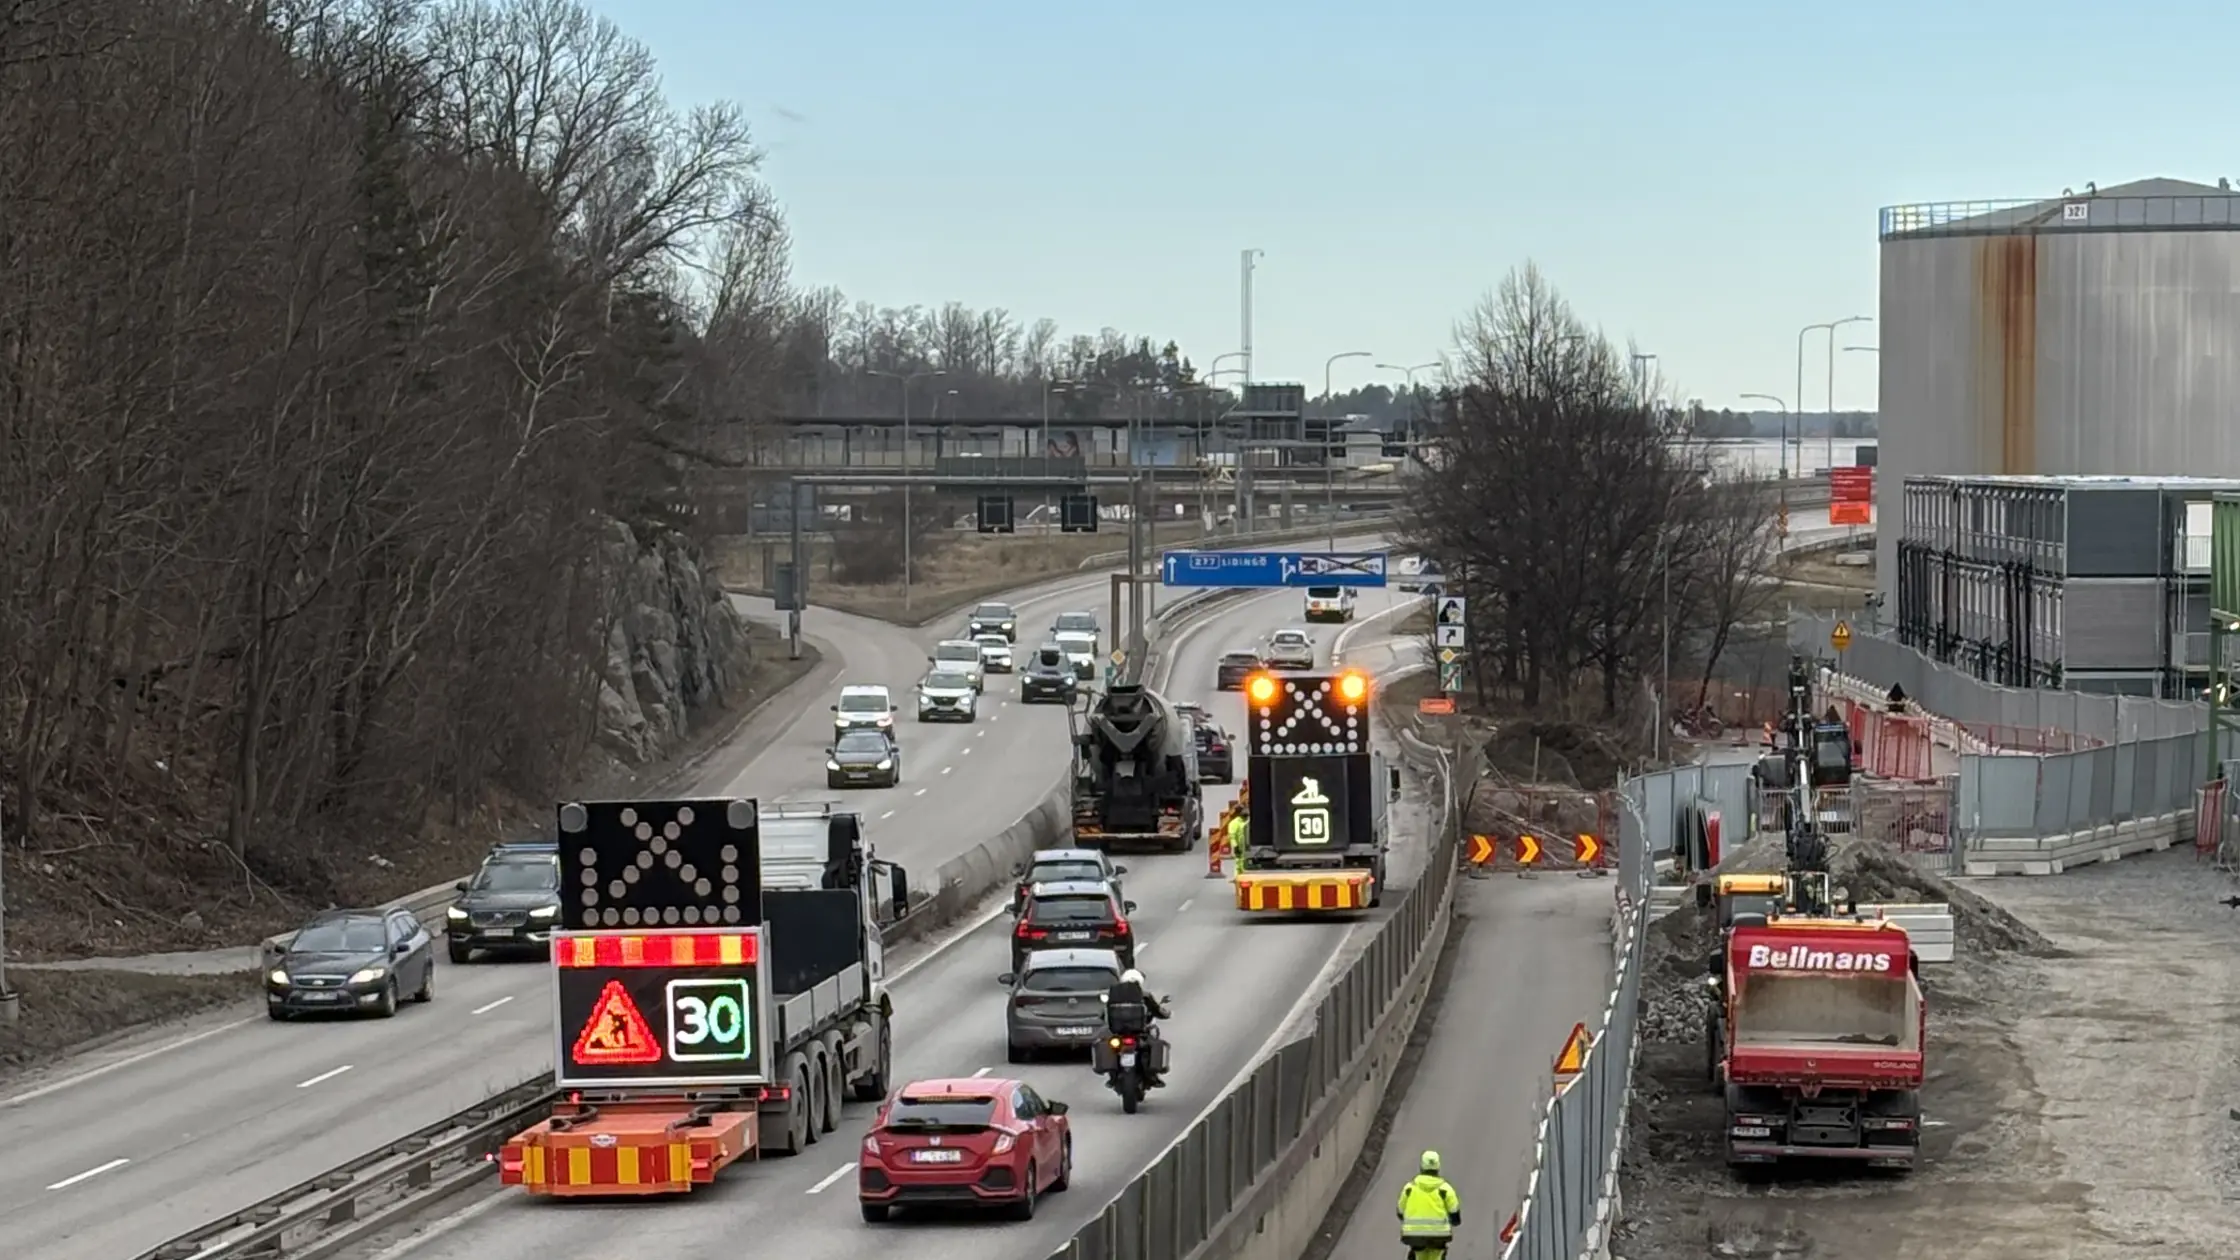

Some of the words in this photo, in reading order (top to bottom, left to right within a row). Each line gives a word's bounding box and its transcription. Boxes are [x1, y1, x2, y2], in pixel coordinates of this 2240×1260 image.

[1194, 558, 1216, 566] 277
[1301, 817, 1322, 836] 30
[1749, 945, 1892, 971] Bellmans
[675, 995, 741, 1044] 30
